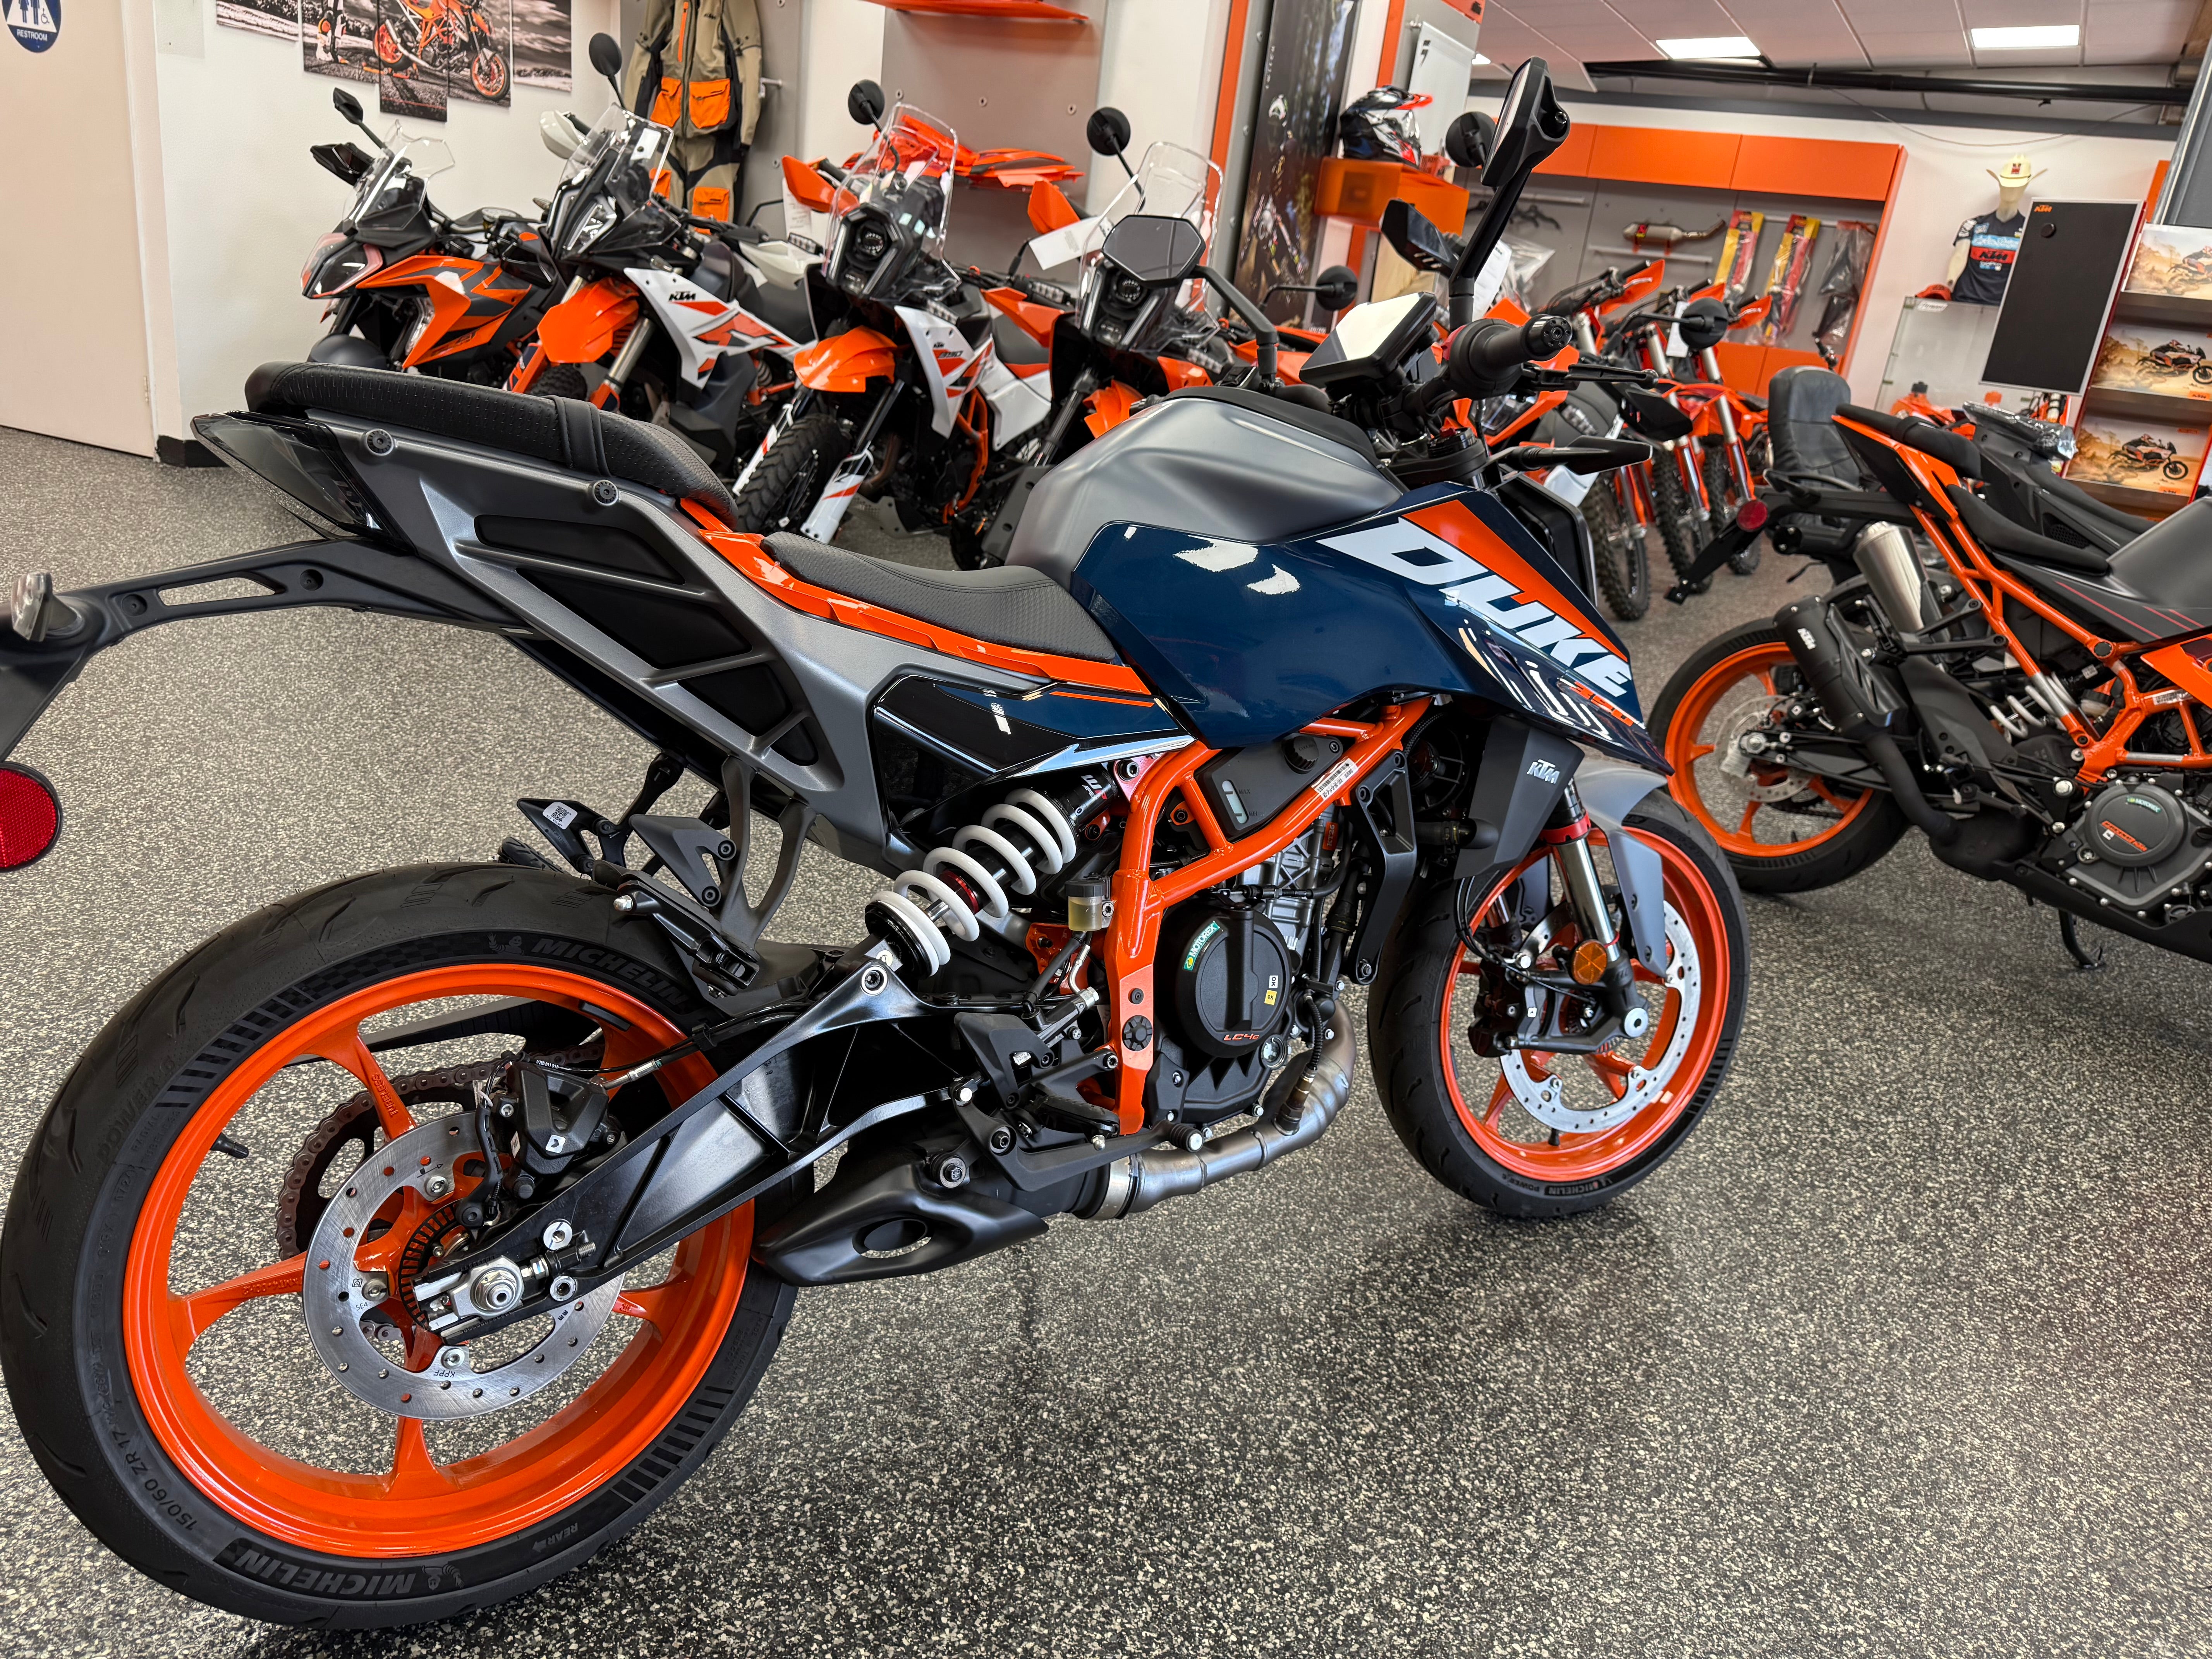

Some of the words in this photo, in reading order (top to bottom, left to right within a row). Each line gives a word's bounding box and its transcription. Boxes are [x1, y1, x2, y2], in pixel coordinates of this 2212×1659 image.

[17, 29, 48, 41] RESTROOM
[669, 292, 696, 301] KTM
[1316, 517, 1632, 697] DUKE
[1527, 759, 1560, 784] KTM
[1189, 922, 1217, 957] MOTOREX
[532, 938, 690, 1005] MICHELIN
[1271, 977, 1276, 986] OK
[372, 1072, 398, 1117] TUBELESS
[98, 1077, 158, 1164] POWER
[1549, 1181, 1598, 1195] MICHELIN
[434, 1369, 455, 1378] KPPF
[112, 1431, 131, 1448] 17
[125, 1451, 148, 1475] ZR
[144, 1479, 197, 1531] 150/60
[548, 1522, 578, 1545] REAR
[234, 1549, 416, 1595] MICHELIN
